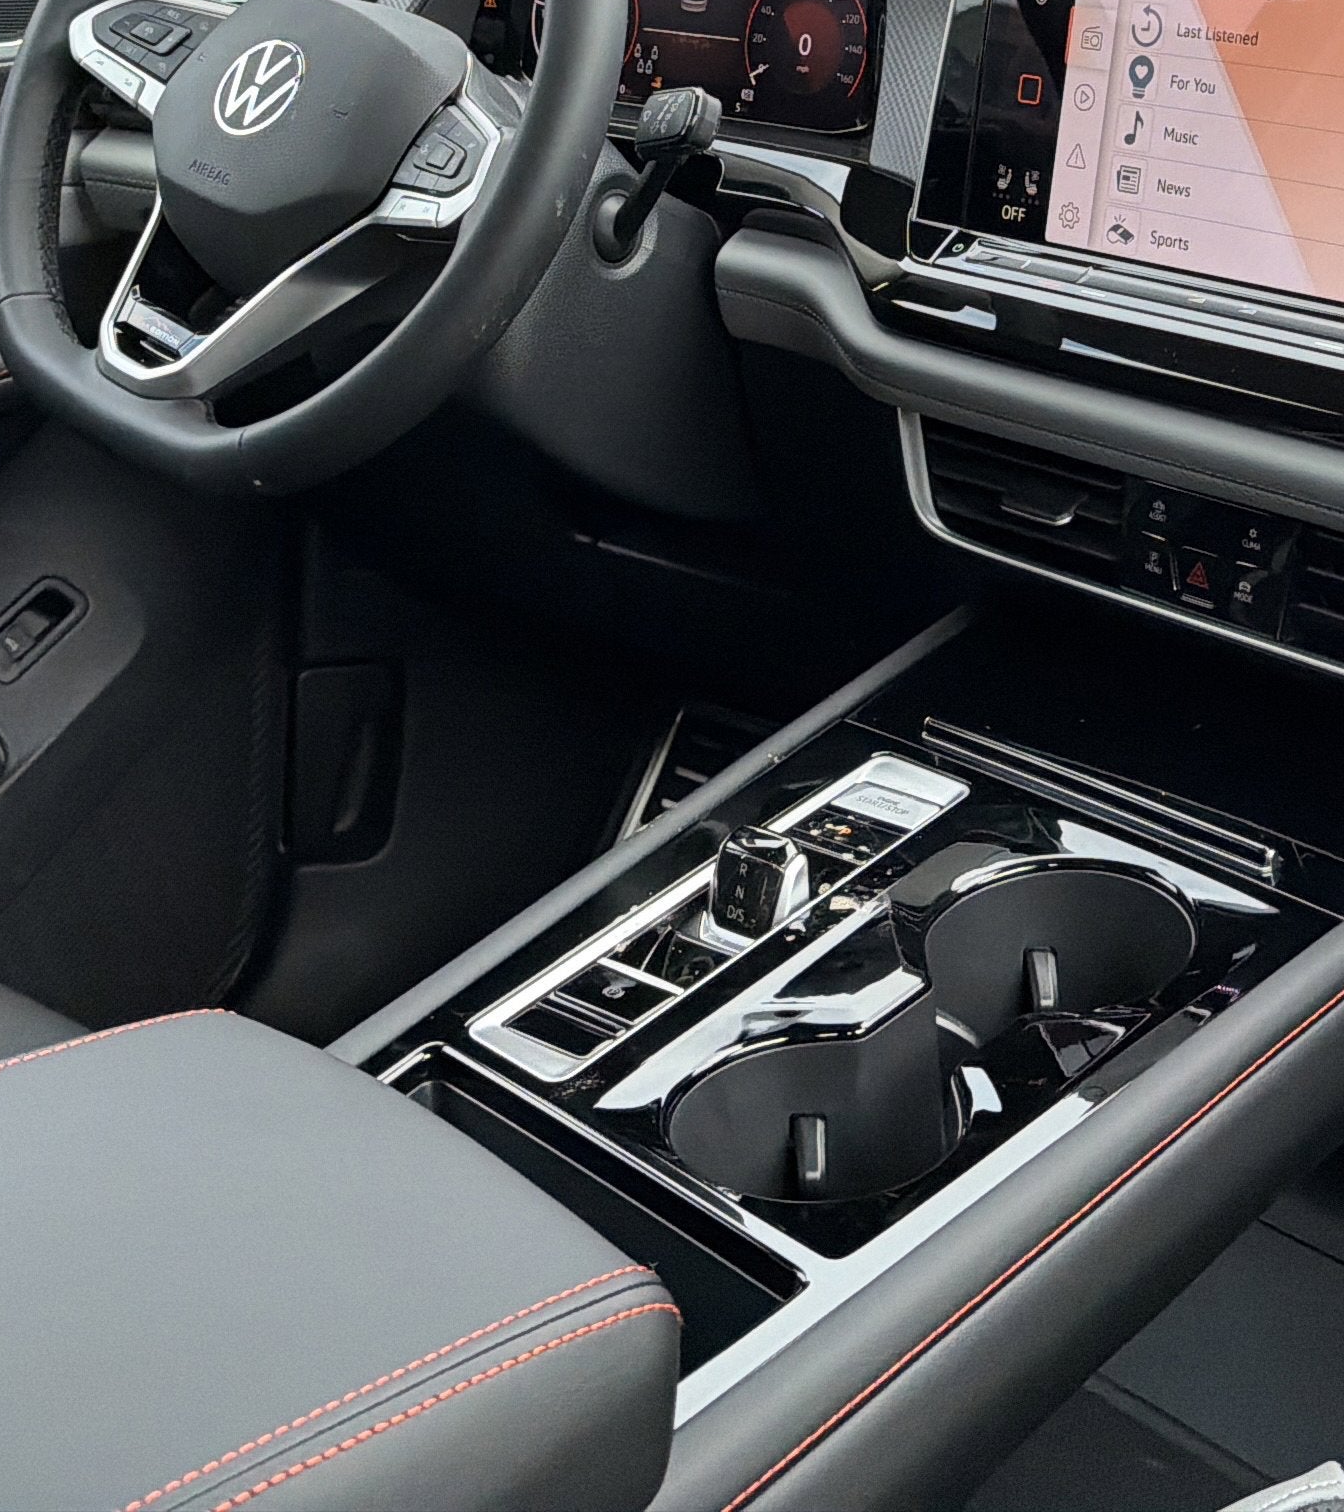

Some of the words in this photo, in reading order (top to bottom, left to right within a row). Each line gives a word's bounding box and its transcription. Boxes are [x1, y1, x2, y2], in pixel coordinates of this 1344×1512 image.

[845, 14, 860, 25] 120
[752, 33, 763, 43] 20
[1176, 23, 1202, 39] Last
[1205, 26, 1259, 46] Listened
[798, 33, 812, 56] 0
[848, 44, 863, 55] 140
[840, 74, 855, 85] 160
[1170, 74, 1190, 91] For
[1193, 77, 1216, 94] You
[1163, 126, 1200, 146] Music
[188, 158, 231, 186] AIRBAG
[1157, 178, 1191, 198] News
[1001, 205, 1027, 222] OFF
[1150, 230, 1189, 251] Sports
[1233, 591, 1254, 604] MODE
[856, 795, 909, 815] START/STOP
[739, 863, 748, 878] R
[734, 885, 744, 900] N
[726, 905, 745, 922] D/S
